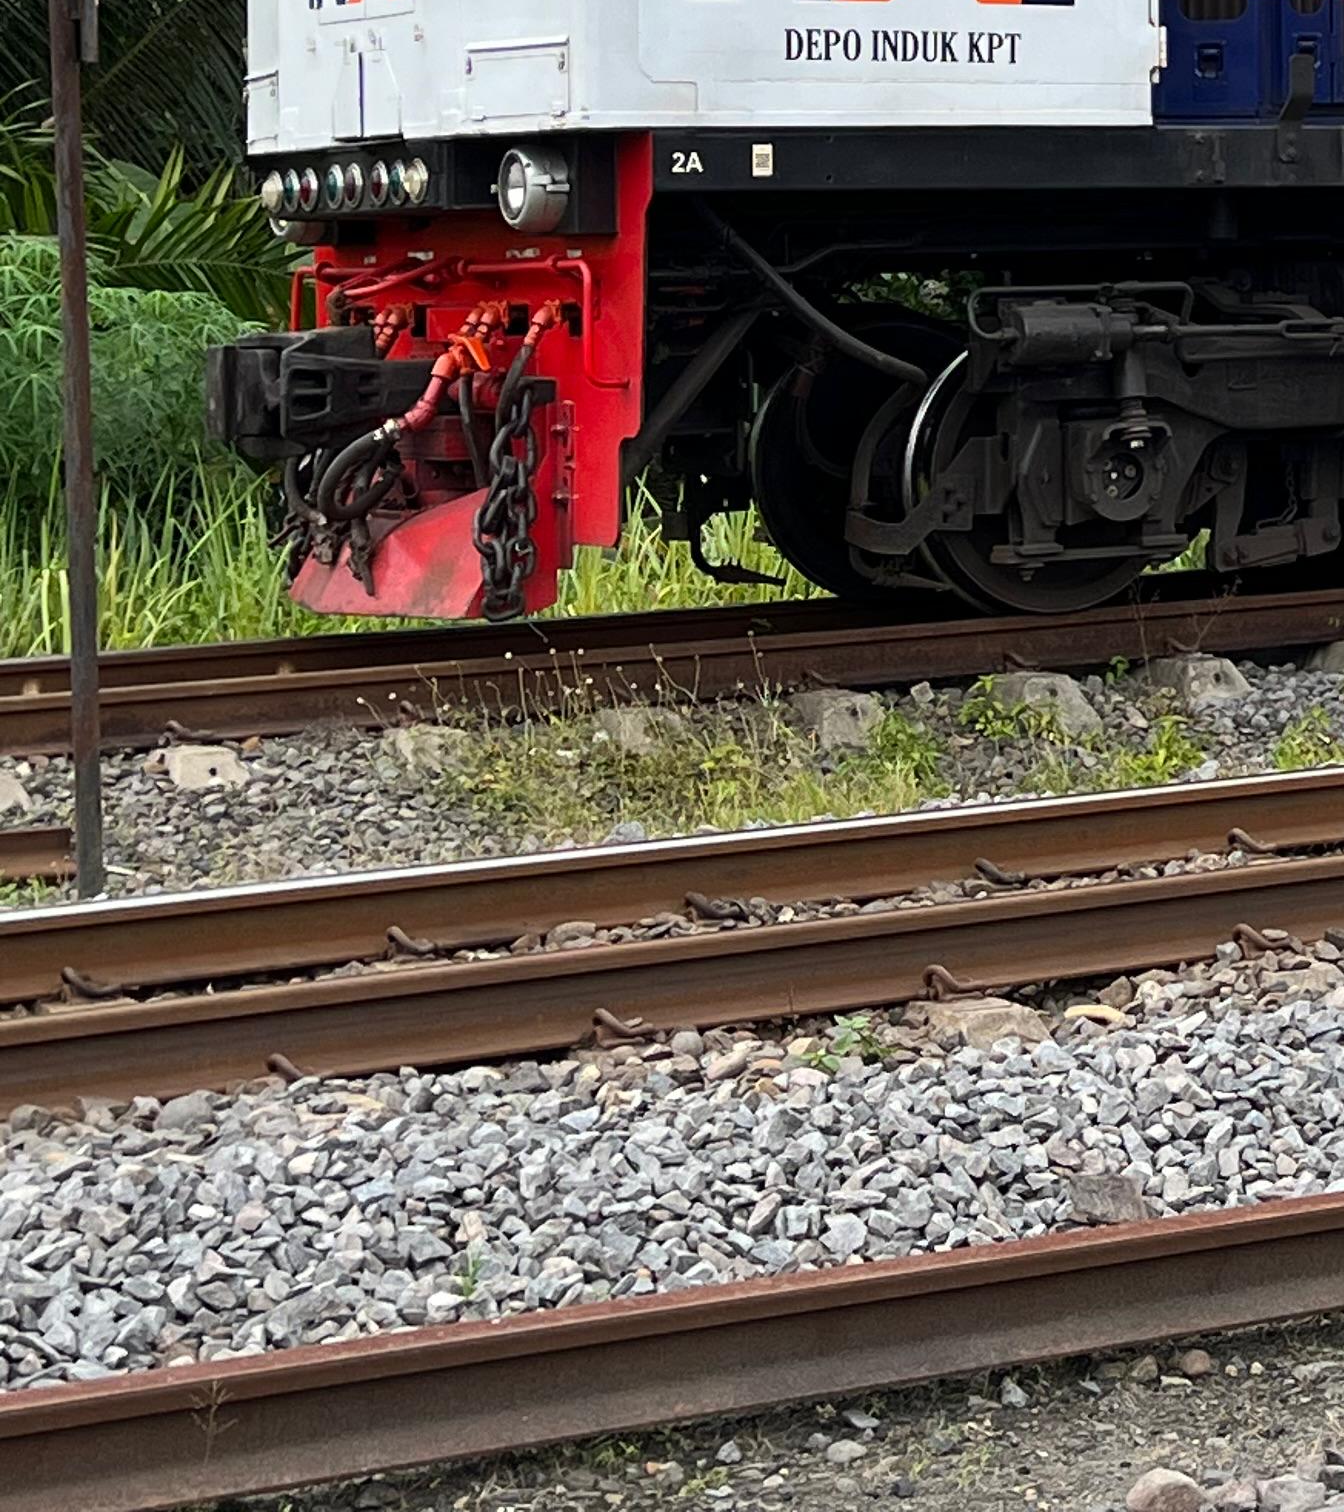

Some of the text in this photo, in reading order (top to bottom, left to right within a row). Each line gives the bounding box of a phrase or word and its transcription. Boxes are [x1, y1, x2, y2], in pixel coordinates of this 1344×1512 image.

[784, 28, 1022, 65] DEPO INDUK KPT
[671, 150, 704, 175] 2A
